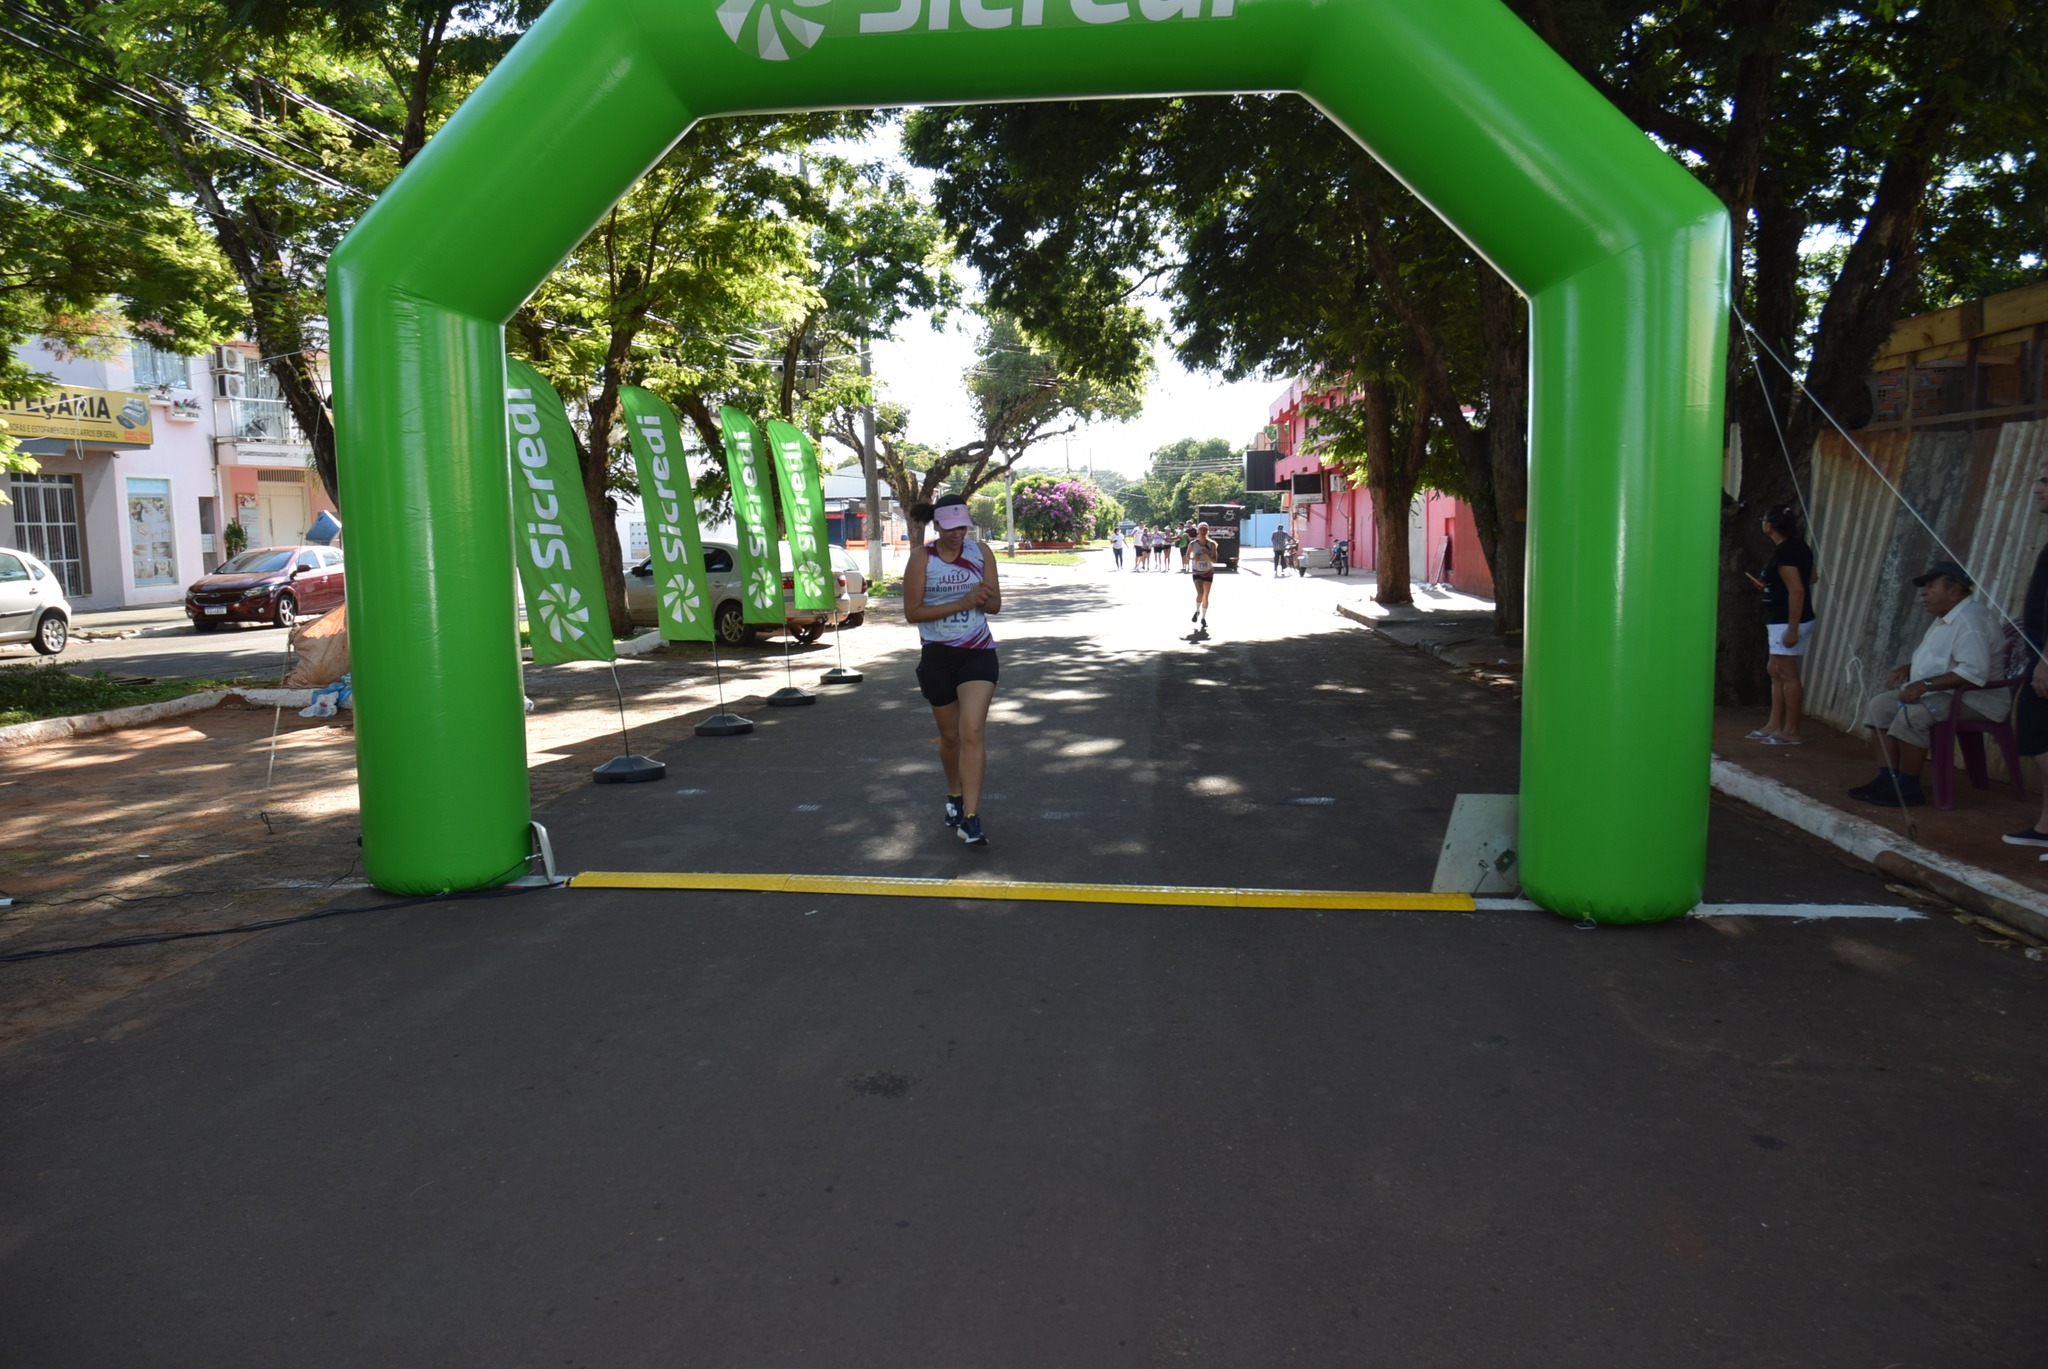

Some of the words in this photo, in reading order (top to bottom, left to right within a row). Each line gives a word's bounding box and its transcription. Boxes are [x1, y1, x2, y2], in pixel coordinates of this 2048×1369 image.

[636, 415, 688, 565] Sicredi
[733, 430, 769, 559] Sicredi
[781, 439, 818, 554] Sicredi
